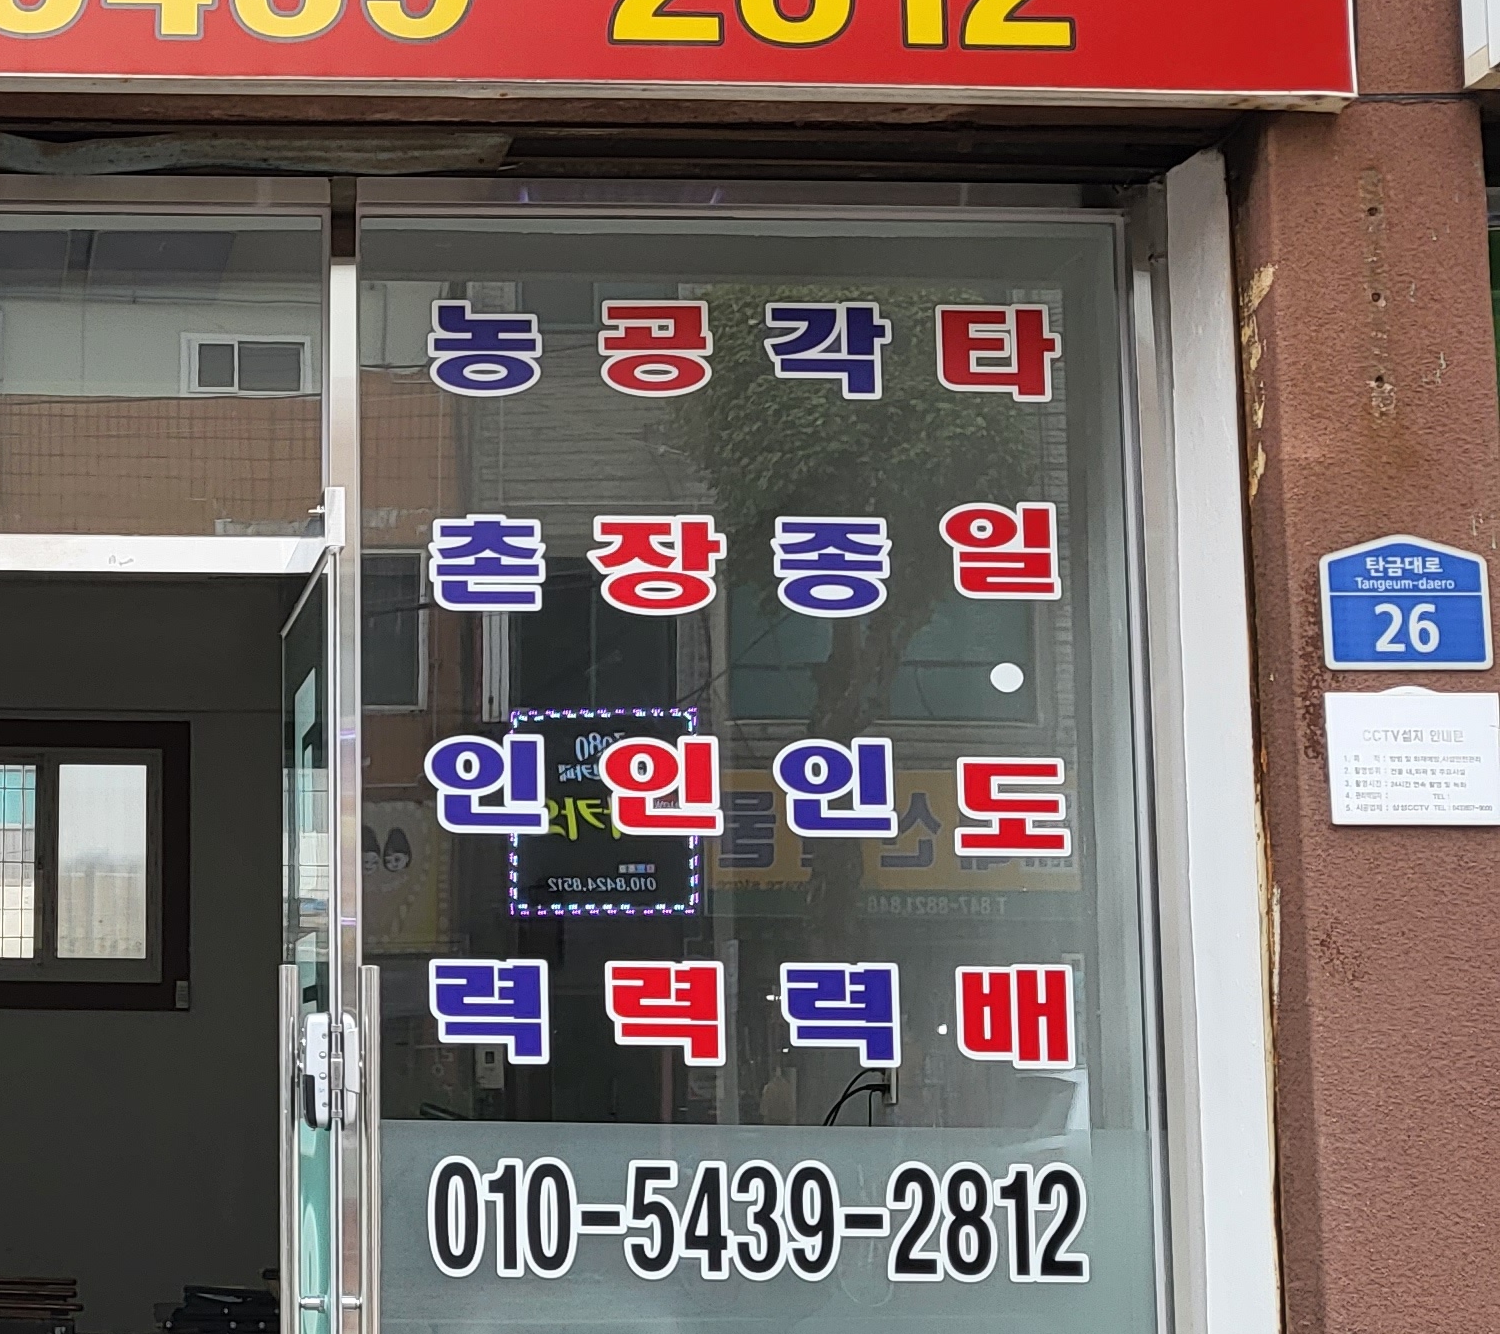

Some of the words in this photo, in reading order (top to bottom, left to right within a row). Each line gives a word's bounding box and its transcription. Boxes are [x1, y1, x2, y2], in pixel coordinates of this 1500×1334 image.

[1365, 556, 1443, 576] 탄금대로
[1354, 576, 1455, 593] Tangeum-daero
[1374, 603, 1440, 654] 26
[427, 1155, 1090, 1284] 010-5439-2812
